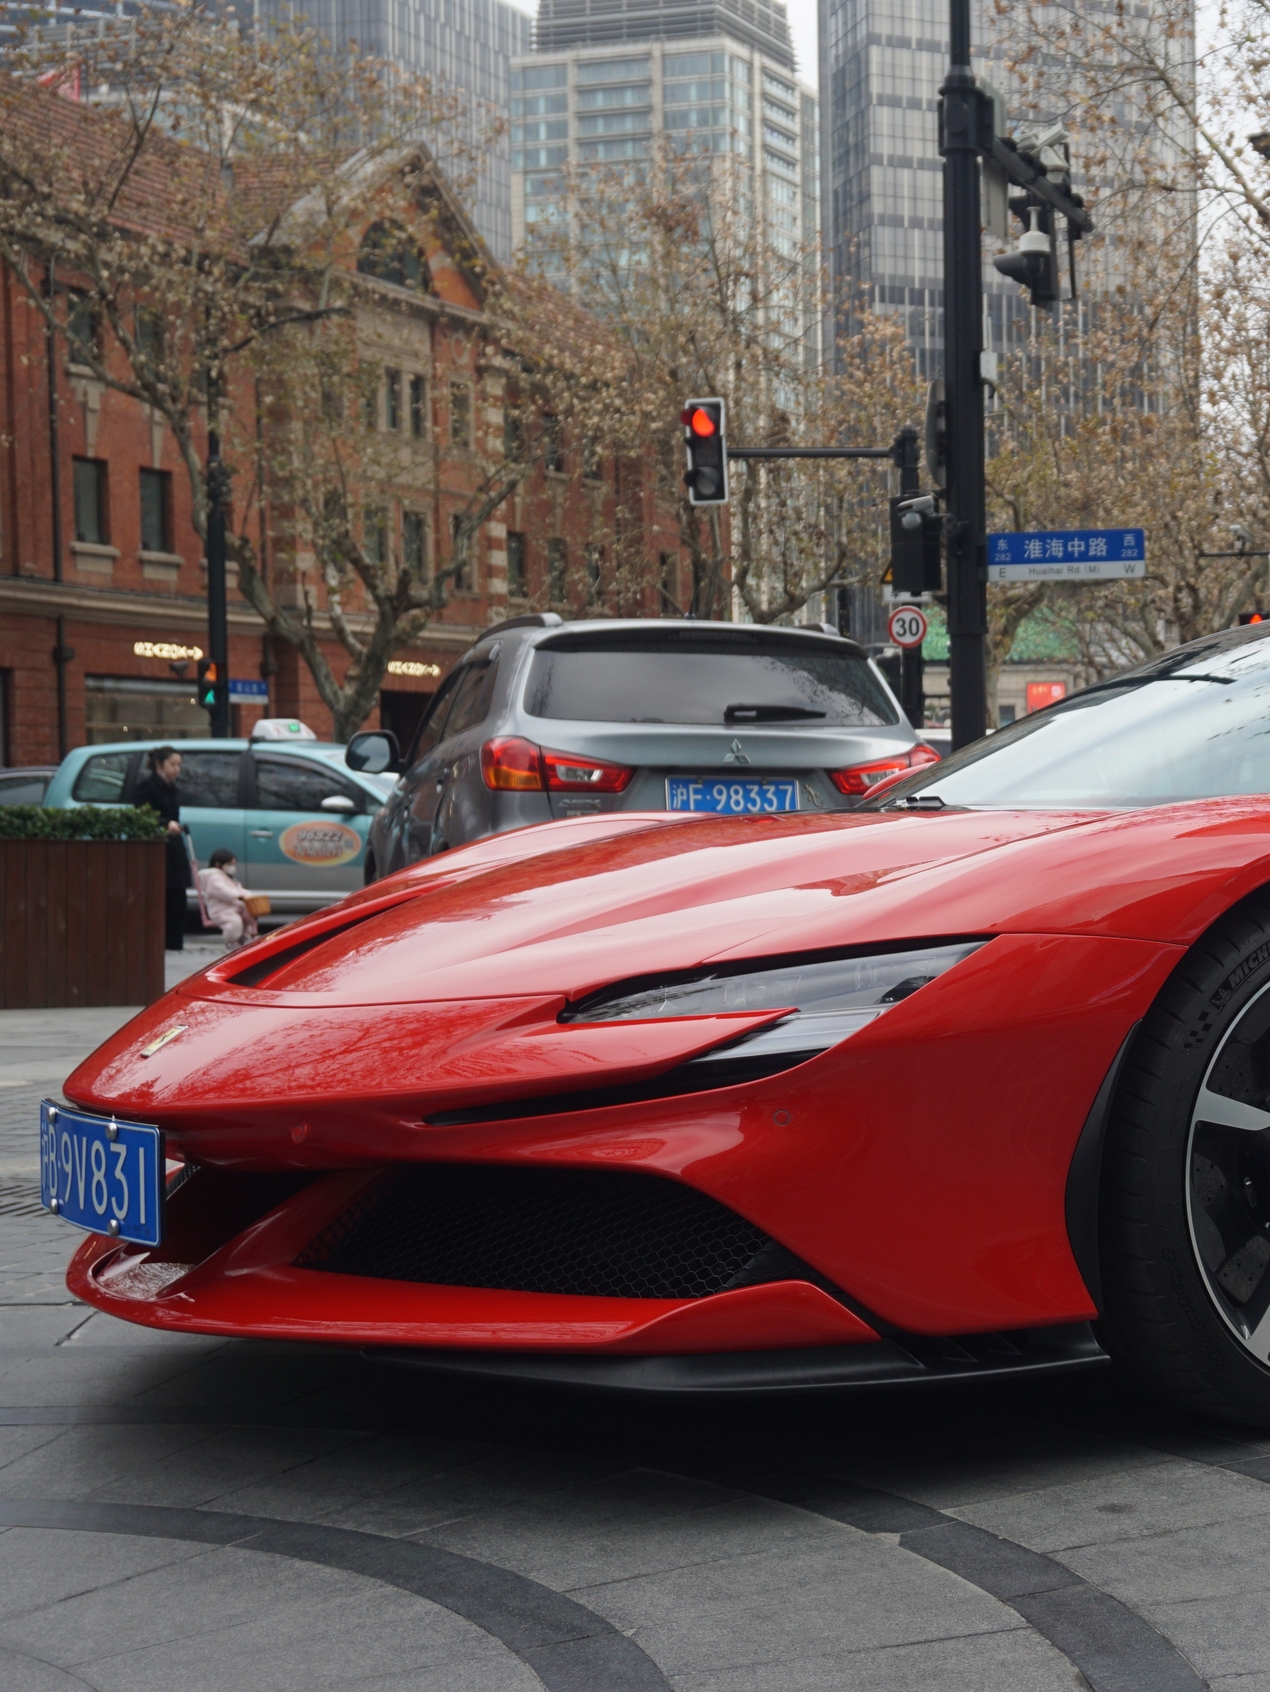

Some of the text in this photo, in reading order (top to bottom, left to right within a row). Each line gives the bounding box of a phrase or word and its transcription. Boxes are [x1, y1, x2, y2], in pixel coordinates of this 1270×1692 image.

[997, 538, 1009, 551] 东
[1122, 533, 1136, 547] 西
[1023, 536, 1108, 559] 淮海中路
[1121, 548, 1138, 557] 282
[994, 552, 1011, 562] 282
[998, 567, 1007, 578] E
[1028, 565, 1063, 576] Huaihai
[1124, 563, 1136, 574] W
[895, 616, 920, 637] 30
[299, 830, 343, 842] 96822
